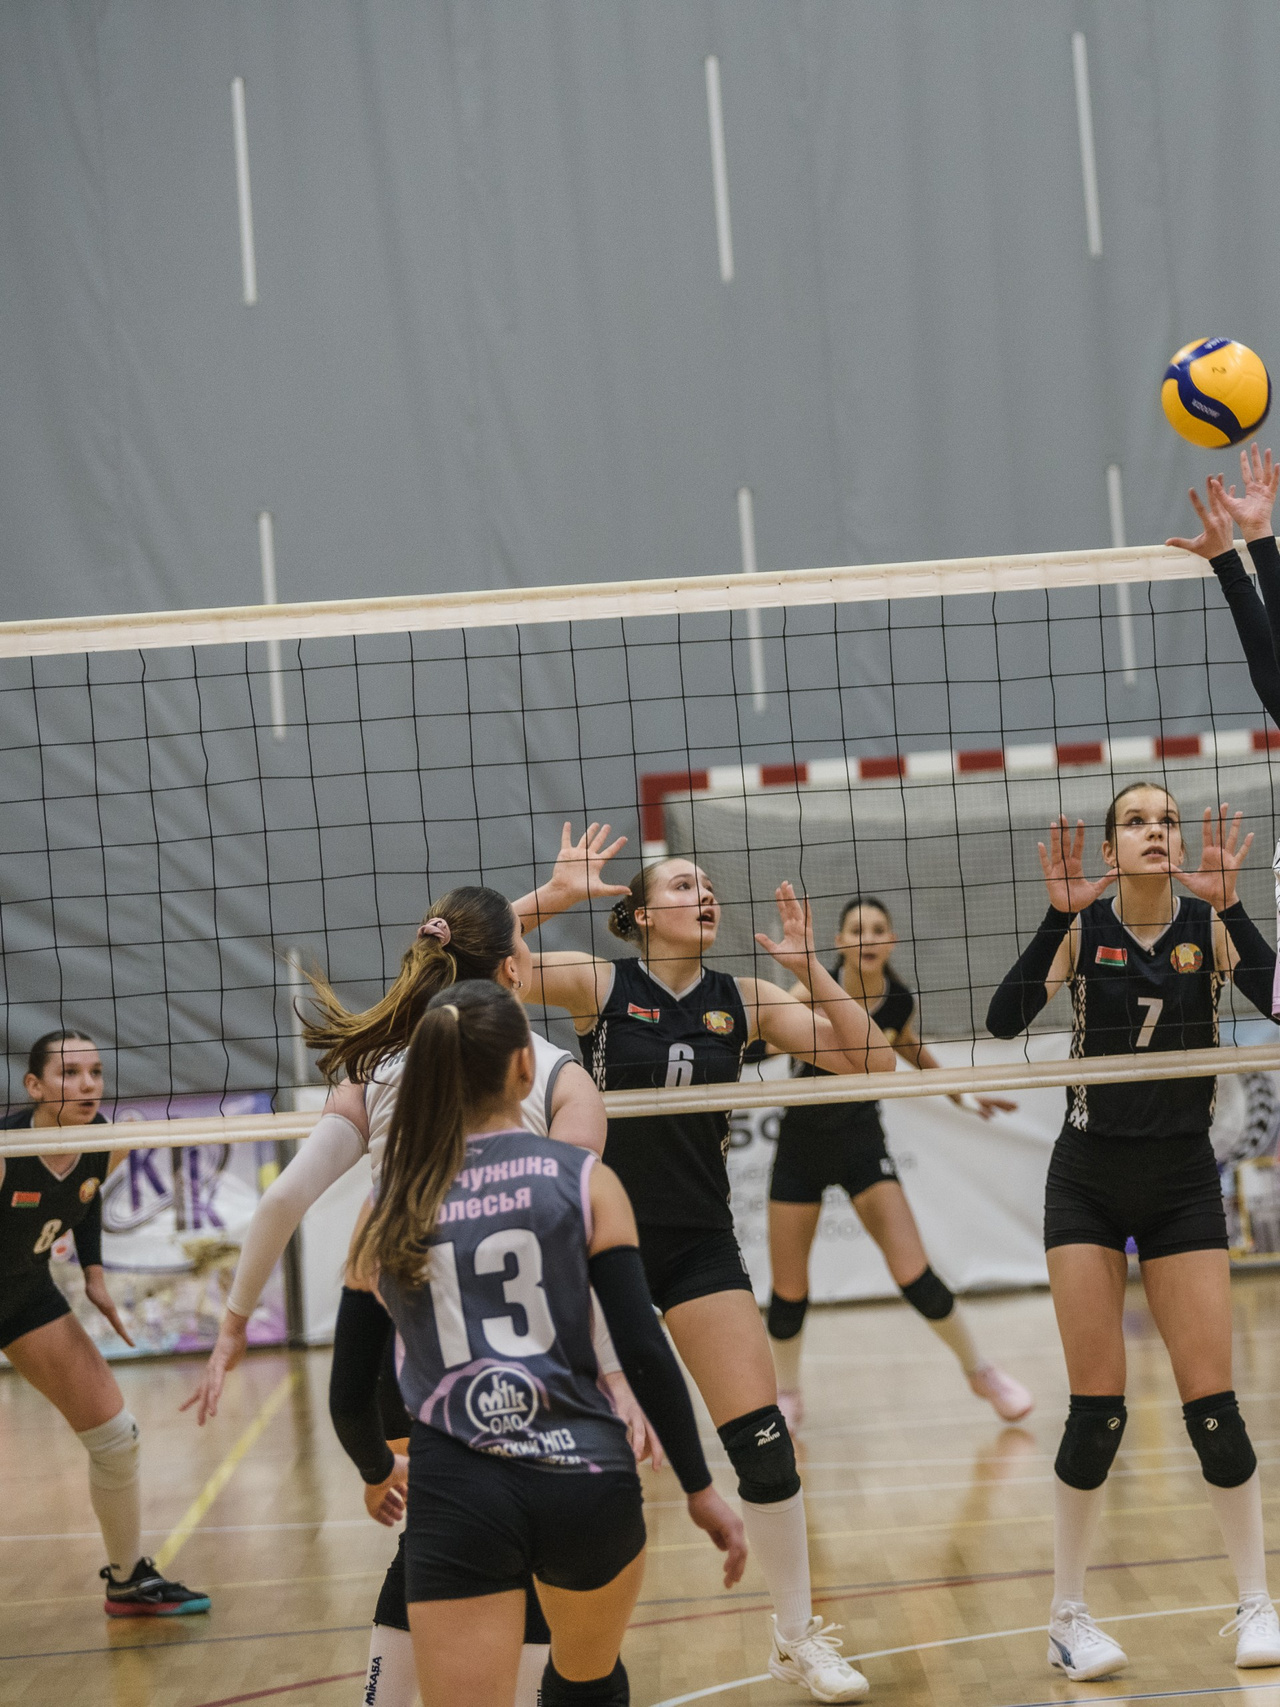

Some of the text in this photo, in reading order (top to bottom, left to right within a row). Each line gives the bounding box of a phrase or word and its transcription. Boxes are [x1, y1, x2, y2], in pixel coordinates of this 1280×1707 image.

[1136, 997, 1164, 1047] 7
[665, 1043, 695, 1087] 6
[455, 1156, 559, 1192] чужина
[436, 1187, 531, 1224] олесья
[33, 1220, 62, 1253] 8
[428, 1227, 557, 1369] 13
